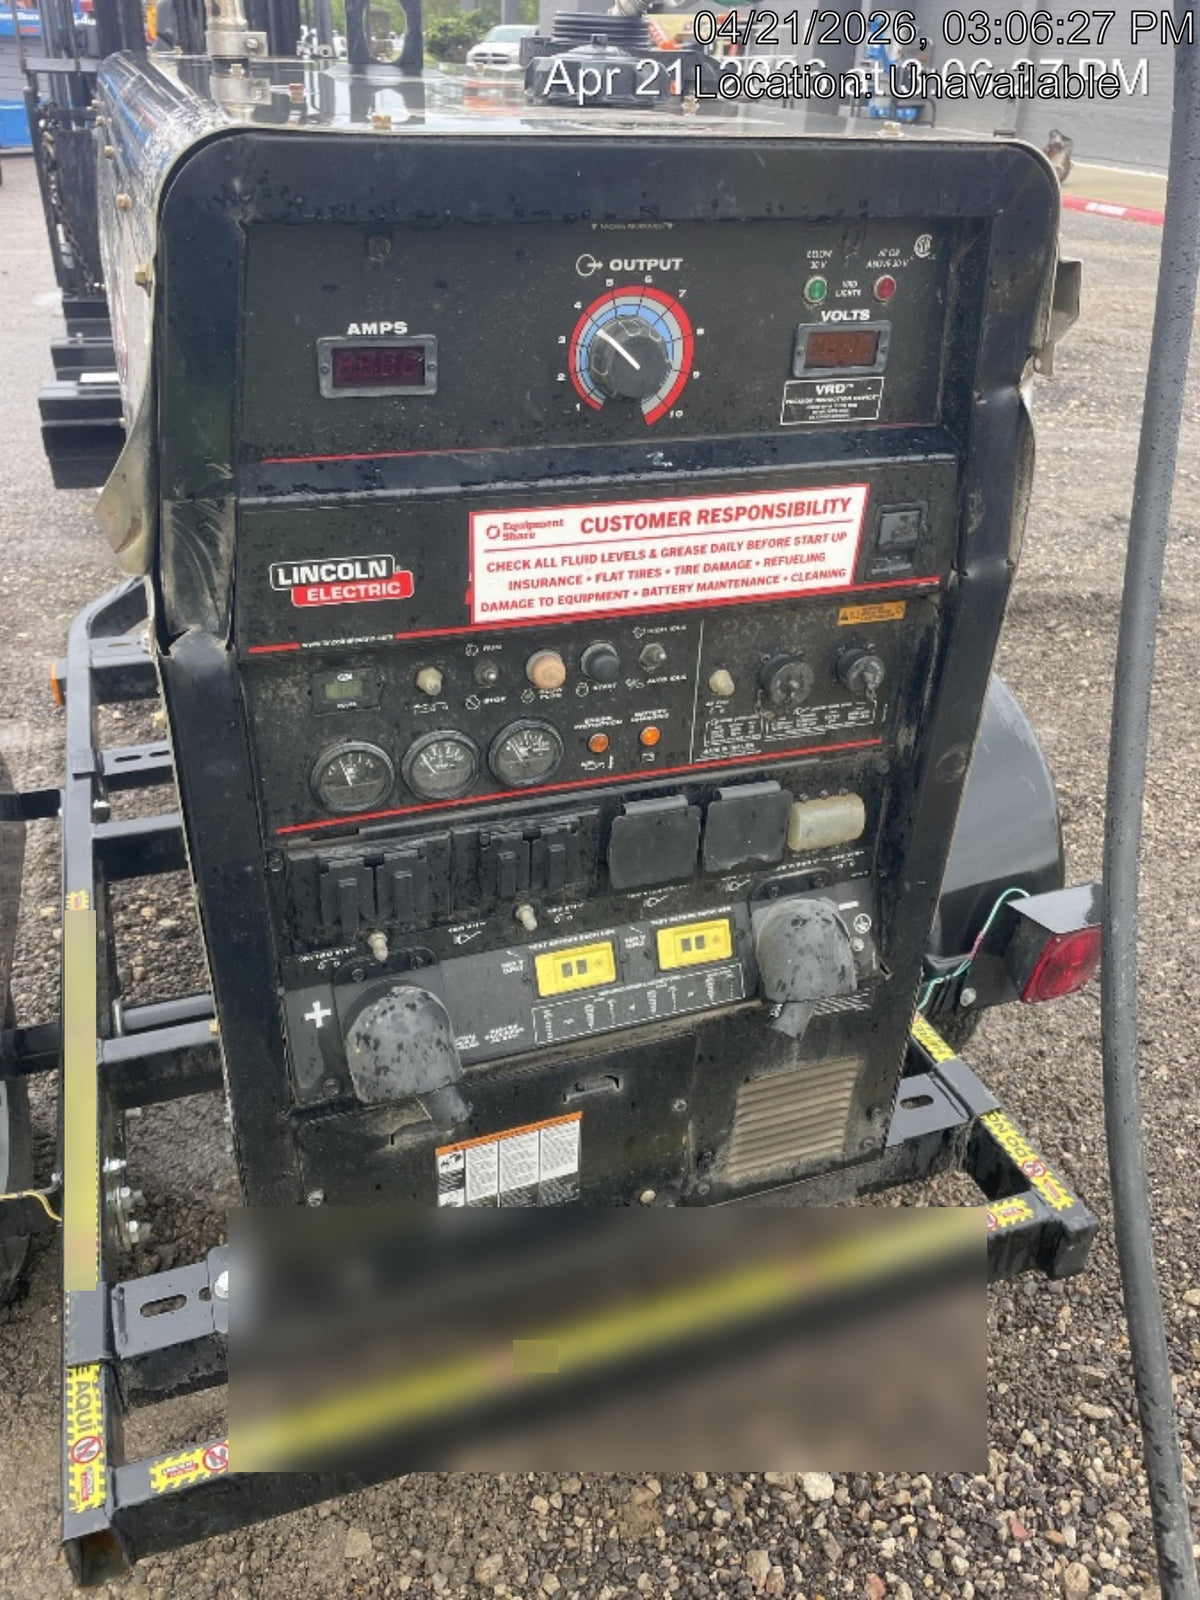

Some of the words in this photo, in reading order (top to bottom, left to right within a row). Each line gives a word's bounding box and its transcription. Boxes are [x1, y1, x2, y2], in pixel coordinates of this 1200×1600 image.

[609, 258, 683, 271] OUTPUT
[606, 279, 614, 287] 5
[645, 276, 653, 284] 6
[679, 289, 687, 297] 7
[574, 301, 582, 310] 4
[821, 309, 870, 321] VOLTS
[346, 321, 408, 335] AMPS
[558, 336, 566, 344] 3
[670, 410, 683, 418] 10
[580, 509, 692, 534] CUSTOMER
[697, 497, 852, 525] RESPONSIBILITY
[502, 518, 565, 531] Equipment
[502, 531, 536, 541] Share
[486, 559, 531, 573] CHECK
[534, 556, 558, 569] ALL
[561, 553, 598, 567] FLUID
[600, 550, 646, 563] LEVELS
[649, 549, 657, 558] &
[661, 543, 707, 558] GREASE
[710, 540, 744, 554] DAILY
[746, 536, 791, 550] BEFORE
[794, 532, 829, 546] START
[832, 531, 847, 542] UP
[277, 559, 387, 585] LINCOLN
[508, 574, 583, 591] INSURANCE
[595, 570, 624, 584] FLAT
[627, 568, 662, 581] TIRES
[674, 563, 700, 576] TIRE
[703, 559, 752, 573] DAMAGE
[763, 552, 826, 568] REFUELING
[306, 581, 401, 602] ELECTRIC
[480, 598, 535, 613] DAMAGE
[539, 596, 554, 607] TO
[557, 589, 630, 606] EQUIPMENT
[641, 582, 694, 598] BATTERY
[696, 575, 780, 593] MAINTENANCE
[790, 568, 847, 583] CLEANING
[483, 696, 507, 704] STOP
[987, 1111, 1008, 1133] NO
[75, 1380, 97, 1433] AQUÍ
